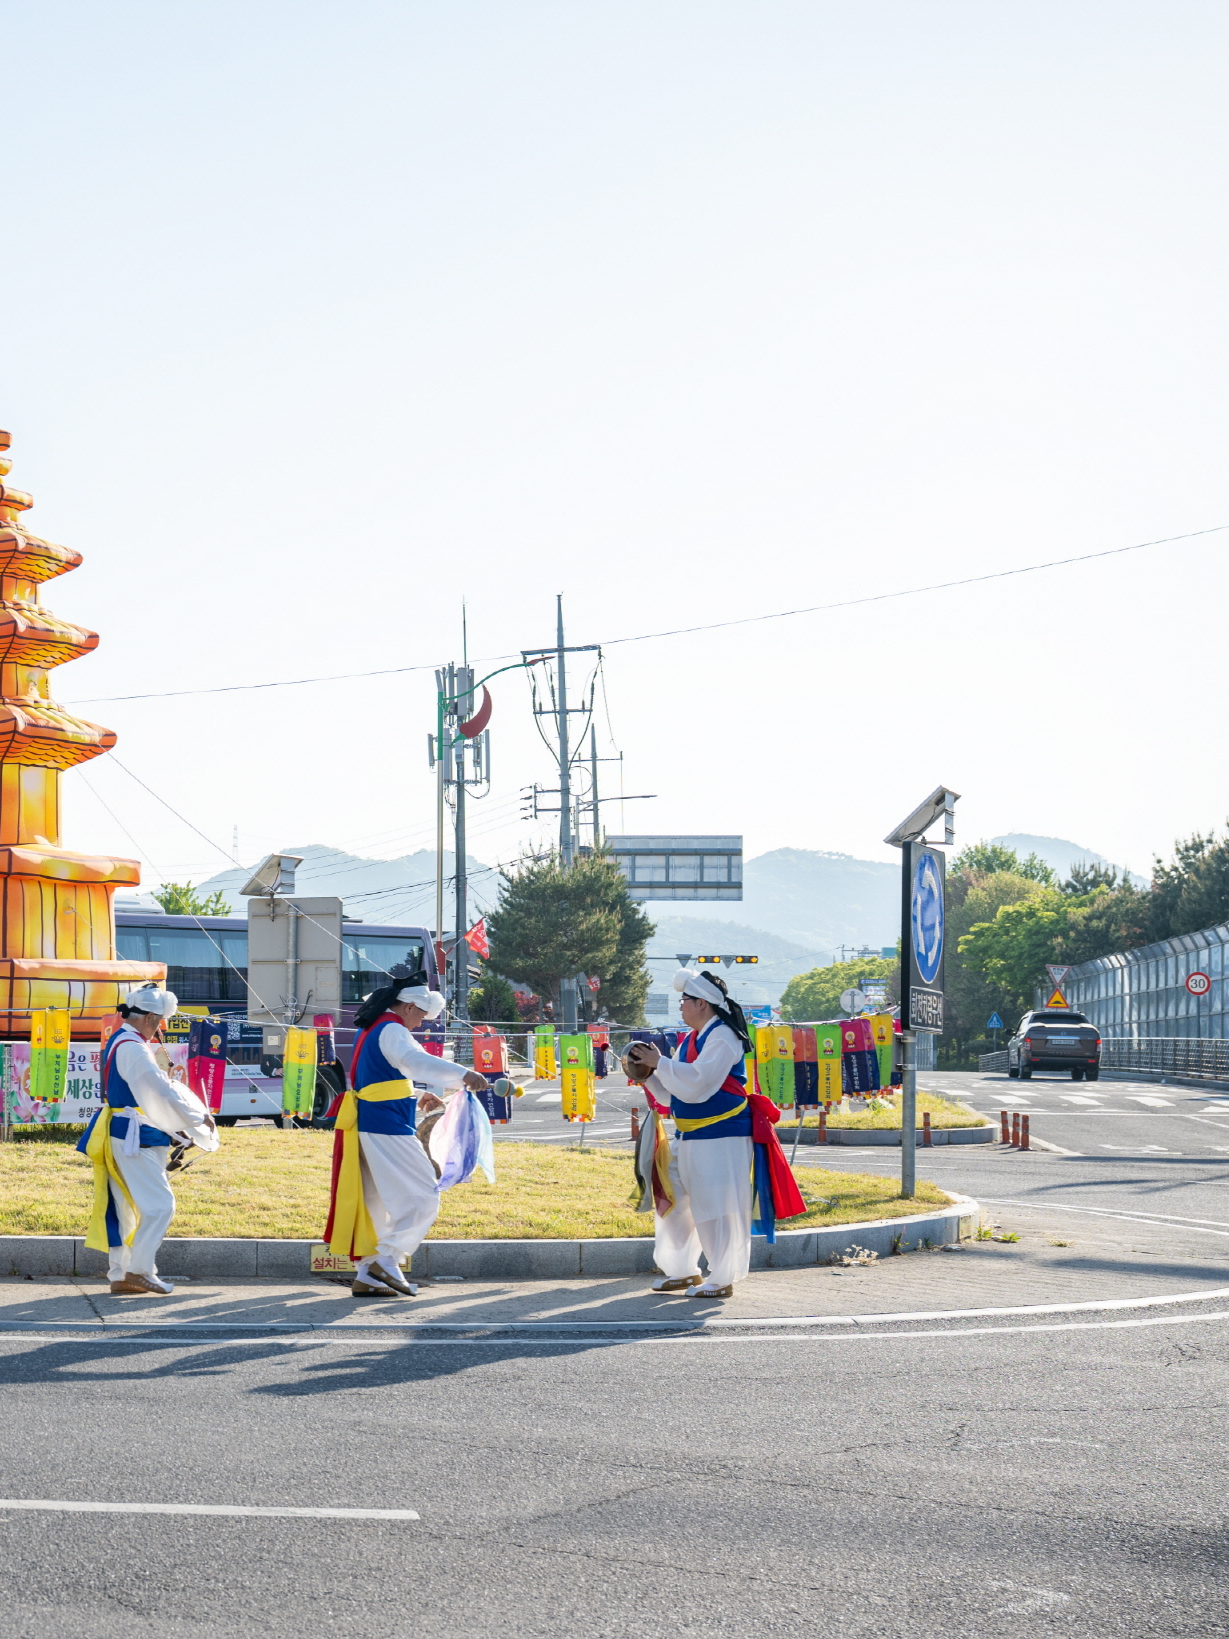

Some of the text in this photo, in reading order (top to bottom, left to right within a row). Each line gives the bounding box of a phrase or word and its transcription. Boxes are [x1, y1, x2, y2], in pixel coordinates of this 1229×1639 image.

[1190, 979, 1206, 989] 30
[53, 1053, 62, 1096] 부처님오신날
[312, 1256, 348, 1270] 설치는
